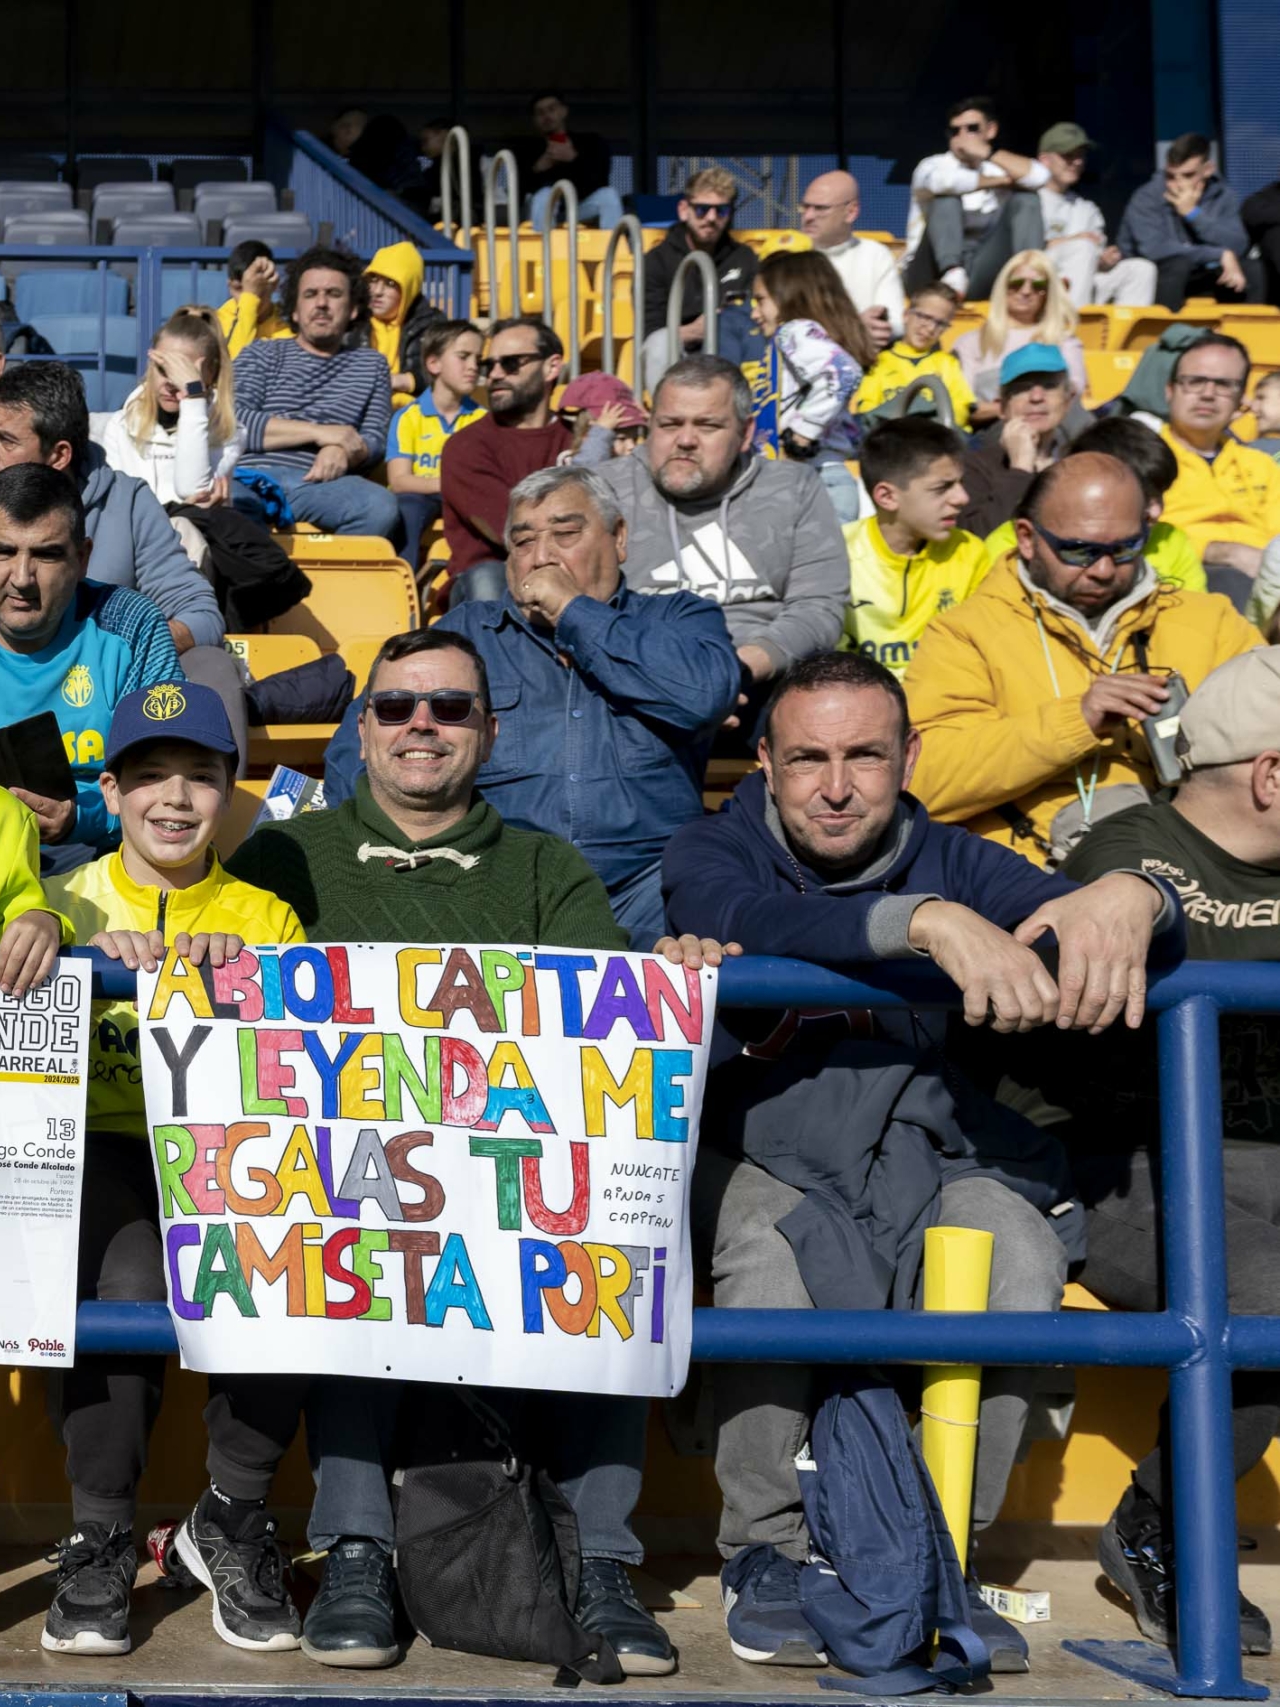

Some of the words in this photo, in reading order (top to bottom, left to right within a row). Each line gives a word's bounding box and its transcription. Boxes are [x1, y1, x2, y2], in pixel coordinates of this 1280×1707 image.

[44, 1075, 80, 1084] 2024/2025
[149, 1025, 213, 1118] Y
[236, 1027, 558, 1135] LEYENDA
[580, 1045, 694, 1142] ME
[46, 1117, 76, 1141] 13
[23, 1142, 76, 1159] Conde
[13, 1161, 39, 1169] Conde
[40, 1162, 75, 1171] Alcolado
[152, 1122, 447, 1223] REGALAS
[469, 1135, 591, 1236] TU
